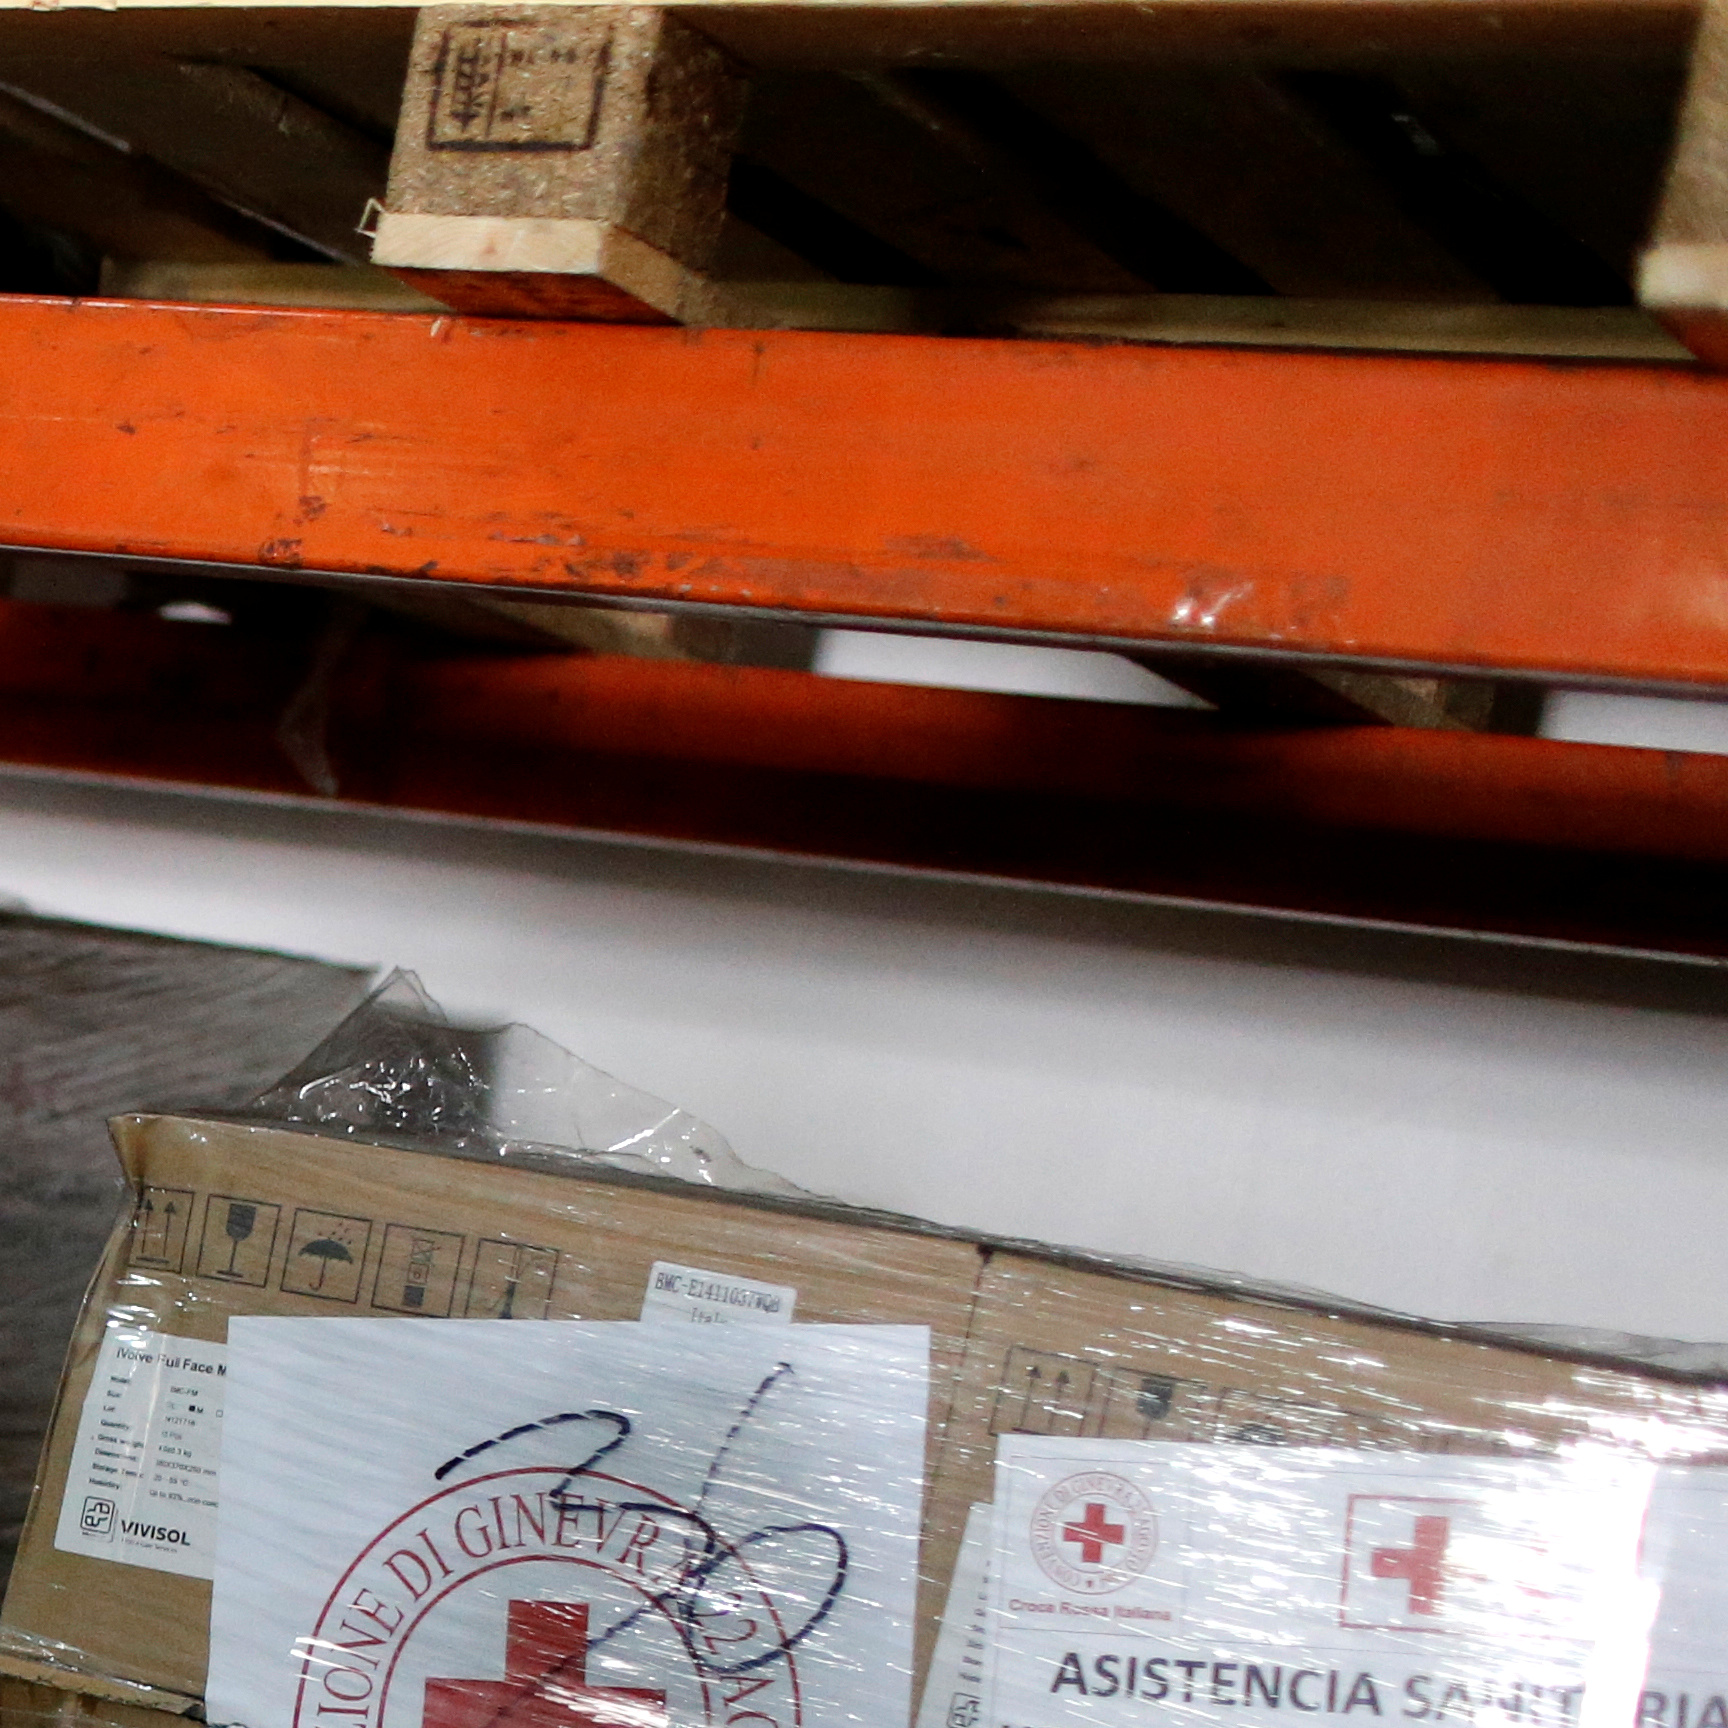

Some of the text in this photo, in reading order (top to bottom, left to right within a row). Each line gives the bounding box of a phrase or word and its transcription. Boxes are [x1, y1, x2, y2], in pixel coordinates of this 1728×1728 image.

[182, 1358, 214, 1374] Face
[121, 1519, 191, 1547] VIVISOL
[382, 1528, 456, 1602] DI
[1049, 1652, 1384, 1717] ASISTENCIA
